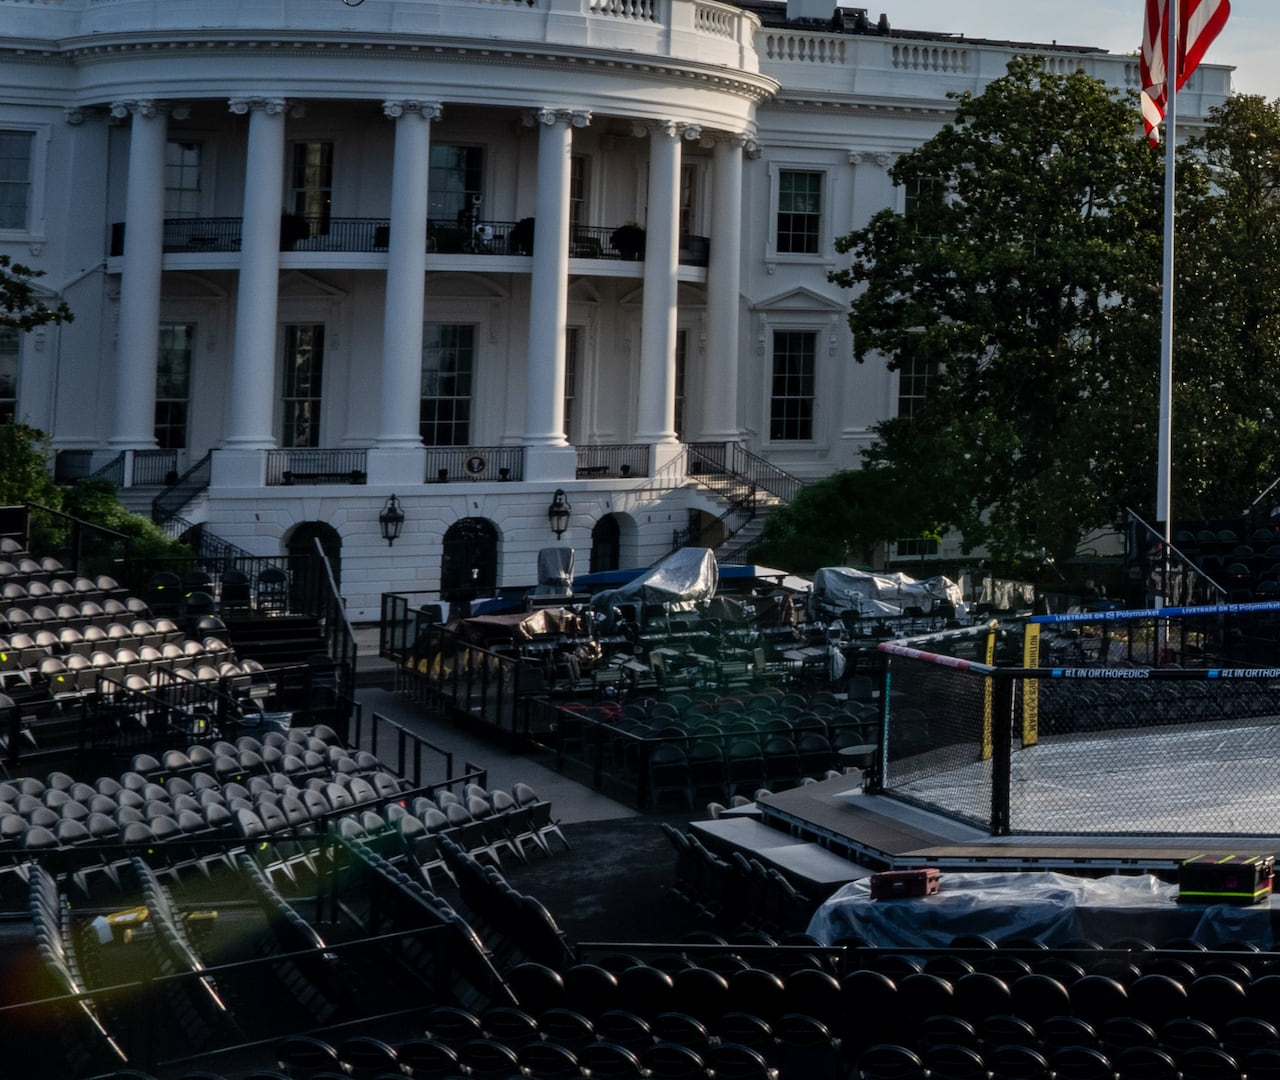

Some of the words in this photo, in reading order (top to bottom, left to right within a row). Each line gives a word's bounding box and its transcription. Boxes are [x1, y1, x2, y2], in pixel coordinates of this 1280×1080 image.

[1239, 602, 1280, 611] Polymarket
[1116, 609, 1160, 619] Polymarket
[1065, 669, 1076, 678] #1
[1077, 669, 1087, 678] IN
[1088, 668, 1150, 678] ORTHOPEDICS
[1221, 669, 1233, 678] #1
[1234, 669, 1245, 678] IN
